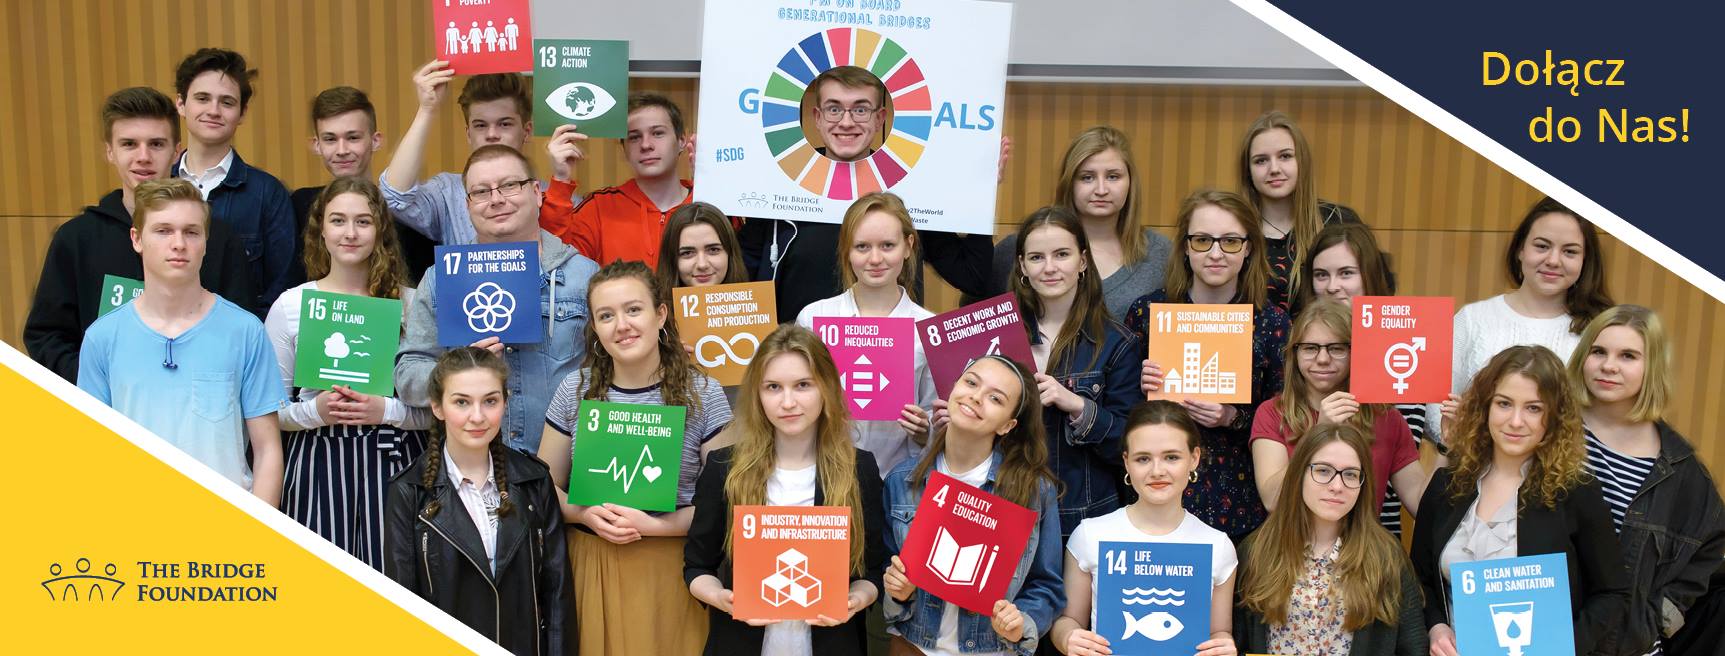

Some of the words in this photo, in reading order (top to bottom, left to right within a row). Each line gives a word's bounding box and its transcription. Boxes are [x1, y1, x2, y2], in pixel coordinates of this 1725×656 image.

[860, 0, 901, 11] BOARD
[778, 7, 873, 25] GENERATIONAL
[878, 14, 931, 30] BRIDGES
[539, 46, 557, 68] 13
[562, 46, 591, 57] CLIMATE
[561, 58, 588, 68] ACTION
[738, 88, 760, 114] G
[933, 102, 995, 131] ALS
[716, 147, 745, 162] #SDG
[774, 194, 788, 202] THE
[791, 196, 819, 204] BRIDGE
[772, 203, 824, 213] FOUNDATION
[467, 249, 525, 262] PARTNERSHIPS
[443, 252, 461, 275] 17
[468, 263, 483, 274] FOR
[484, 262, 500, 273] THE
[501, 261, 527, 272] GOALS
[111, 284, 124, 307] 3
[705, 290, 753, 303] RESPONSIBLE
[307, 298, 327, 320] 15
[332, 300, 348, 311] LIFE
[680, 294, 700, 317] 12
[706, 302, 758, 316] CONSUMPTION
[1381, 305, 1411, 316] GENDER
[331, 312, 343, 322] ON
[344, 314, 365, 325] LAND
[707, 317, 723, 328] AND
[724, 314, 770, 327] PRODUCTION
[943, 313, 972, 331] DECENT
[972, 307, 997, 322] WORK
[996, 301, 1013, 314] AND
[1156, 311, 1172, 333] 11
[1176, 311, 1226, 321] SUSTAINABLE
[1226, 311, 1250, 322] CITIES
[1361, 304, 1373, 328] 5
[844, 325, 879, 335] REDUCED
[946, 323, 986, 343] ECONOMIC
[986, 312, 1019, 331] GROWTH
[1176, 323, 1192, 333] AND
[1193, 323, 1244, 333] COMMUNITIES
[1381, 318, 1417, 329] EQUALITY
[819, 324, 839, 346] 10
[844, 337, 894, 347] INEQUALITIES
[927, 325, 942, 347] 8
[587, 408, 600, 432] 3
[608, 410, 630, 422] GOOD
[631, 412, 662, 424] HEALTH
[607, 423, 624, 434] AND
[626, 424, 672, 437] WELL-BEING
[932, 484, 950, 508] 4
[957, 491, 993, 513] QUALITY
[761, 514, 801, 527] INDUSTRY,
[801, 515, 848, 526] INNOVATION
[952, 503, 998, 531] EDUCATION
[742, 513, 756, 539] 9
[761, 528, 778, 539] AND
[779, 528, 847, 540] INFRASTRUCTURE
[1105, 550, 1127, 575] 14
[1134, 550, 1152, 562] LIFE
[1134, 564, 1163, 576] BELOW
[1165, 565, 1194, 577] WATER
[1483, 567, 1511, 580] CLEAN
[1512, 564, 1542, 577] WATER
[1461, 570, 1476, 595] 6
[1485, 581, 1503, 593] AND
[1504, 577, 1555, 592] SANITATION
